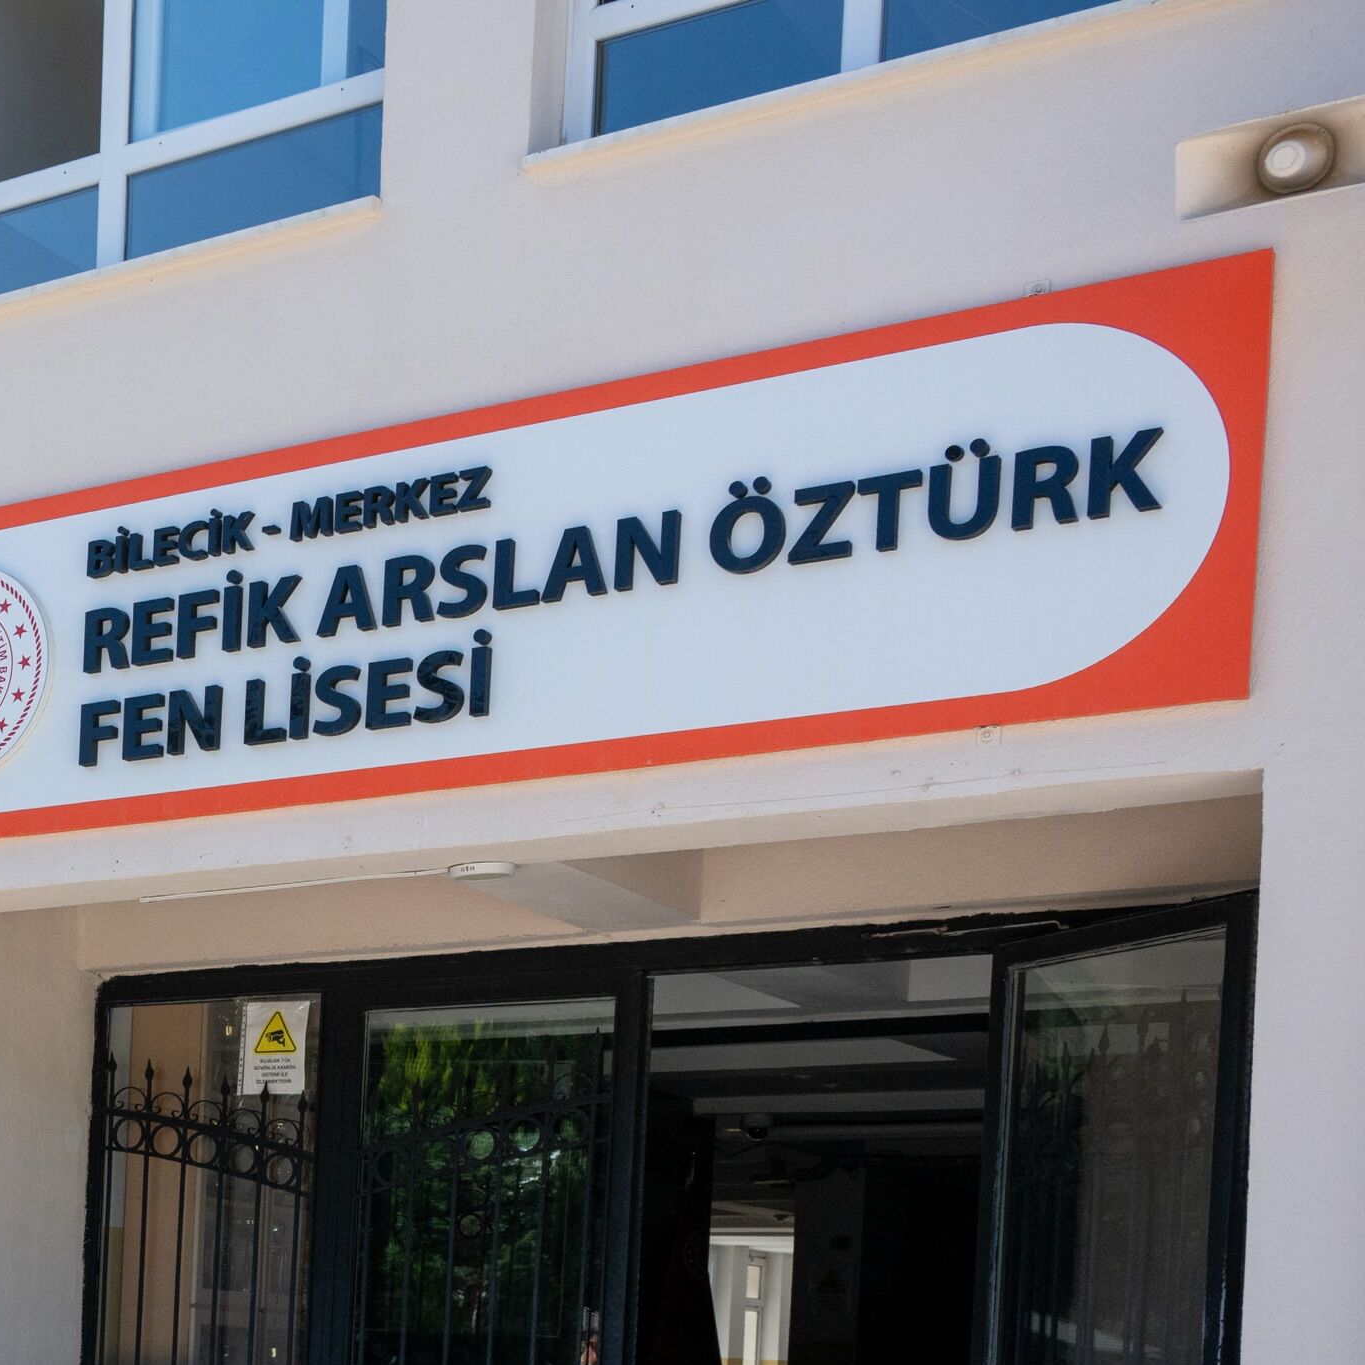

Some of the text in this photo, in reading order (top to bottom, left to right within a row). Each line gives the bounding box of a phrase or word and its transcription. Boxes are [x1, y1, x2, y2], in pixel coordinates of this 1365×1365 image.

[82, 426, 1165, 675] REFİK ARSLAN ÖZTÜRK
[86, 465, 493, 580] BİLECİK - MERKEZ
[78, 628, 493, 768] FEN LİSESİ
